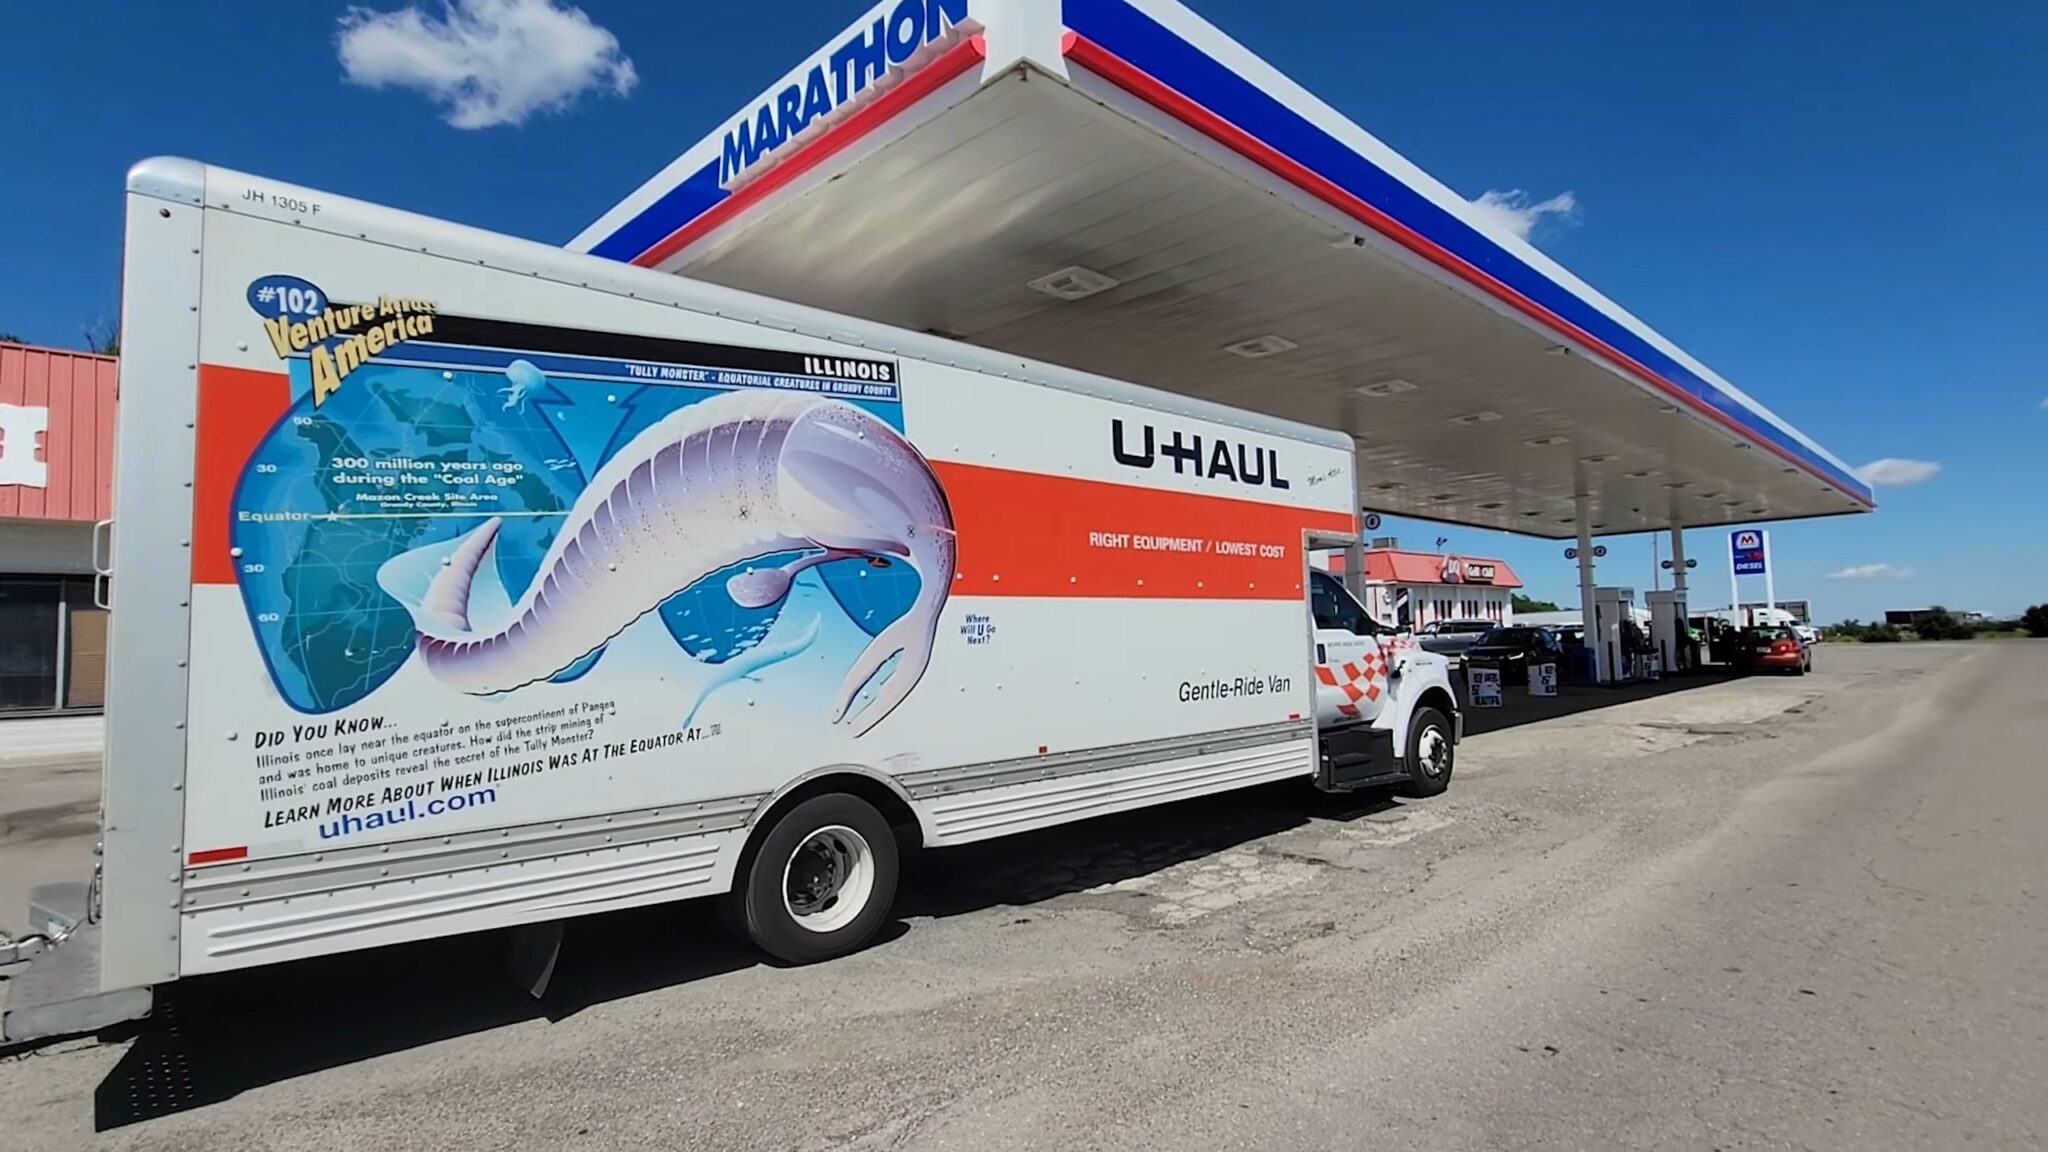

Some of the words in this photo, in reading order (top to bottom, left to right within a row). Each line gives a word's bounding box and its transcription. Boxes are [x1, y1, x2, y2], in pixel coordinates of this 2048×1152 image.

[721, 0, 968, 185] MARATHON
[242, 189, 264, 203] JH
[271, 195, 308, 213] 1305
[312, 203, 321, 215] F
[257, 286, 318, 315] #102
[264, 302, 376, 359] Venture
[311, 314, 433, 410] America
[804, 357, 890, 380] ILLINOIS
[718, 372, 772, 387] EQUATORIAL
[774, 377, 820, 391] CREATURES
[256, 464, 277, 473] 30
[332, 457, 369, 469] 300
[375, 458, 435, 470] million
[440, 461, 487, 473] years
[492, 461, 524, 473] ago
[333, 473, 395, 486] during
[401, 474, 428, 485] the
[434, 474, 479, 485] "Coal
[484, 474, 523, 486] Age"
[356, 493, 400, 501] Mazon
[404, 493, 440, 501] Creek
[444, 493, 467, 501] Site
[470, 493, 498, 501] Area
[238, 511, 311, 523] Equator
[1089, 532, 1130, 548] RIGHT
[1133, 535, 1203, 553] EQUIPMENT
[1215, 541, 1257, 556] LOWEST
[1259, 544, 1285, 558] COST
[244, 563, 265, 573] 30
[1736, 562, 1763, 570] DIESEL
[258, 612, 279, 622] 60
[966, 614, 990, 623] Where
[961, 625, 976, 634] Will
[977, 624, 984, 636] U
[986, 624, 996, 634] Go
[968, 634, 991, 644] Next?
[1179, 678, 1264, 702] Gentle-Ride
[1267, 675, 1291, 694] Van
[255, 731, 285, 749] DID
[293, 724, 327, 743] YOU
[256, 753, 300, 769] Illinois
[306, 747, 334, 760] once
[339, 742, 356, 755] lay
[361, 738, 386, 751] near
[391, 733, 409, 745] the
[413, 726, 454, 741] equator
[458, 724, 471, 734] on
[475, 720, 492, 731] the
[495, 708, 565, 727] supercontinent
[568, 703, 579, 715] of
[582, 700, 615, 713] Pangea
[259, 771, 282, 785] and
[287, 768, 311, 779] was
[316, 761, 350, 774] home
[355, 757, 366, 768] to
[371, 748, 408, 765] unique
[412, 743, 466, 757] creatures.
[470, 736, 493, 747] How
[496, 730, 512, 742] did
[516, 727, 531, 738] the
[535, 723, 556, 736] strip
[561, 718, 591, 730] mining
[595, 713, 604, 724] of
[312, 778, 337, 792] coal
[342, 768, 391, 786] deposits
[395, 761, 429, 776] reveal
[433, 757, 450, 769] the
[454, 751, 485, 765] secret
[489, 747, 501, 758] of
[504, 745, 520, 756] the
[524, 739, 547, 752] Tully
[551, 729, 594, 747] Monster?
[264, 803, 321, 828] LEARN
[327, 793, 375, 815] MORE
[381, 780, 434, 804] ABOUT
[440, 771, 482, 792] WHEN
[487, 760, 543, 783] ILLINOIS
[549, 753, 578, 770] WAS
[582, 748, 599, 763] AT
[604, 743, 626, 759] THE
[630, 732, 683, 754] EQUATOR
[319, 788, 496, 839] uhaul.com
